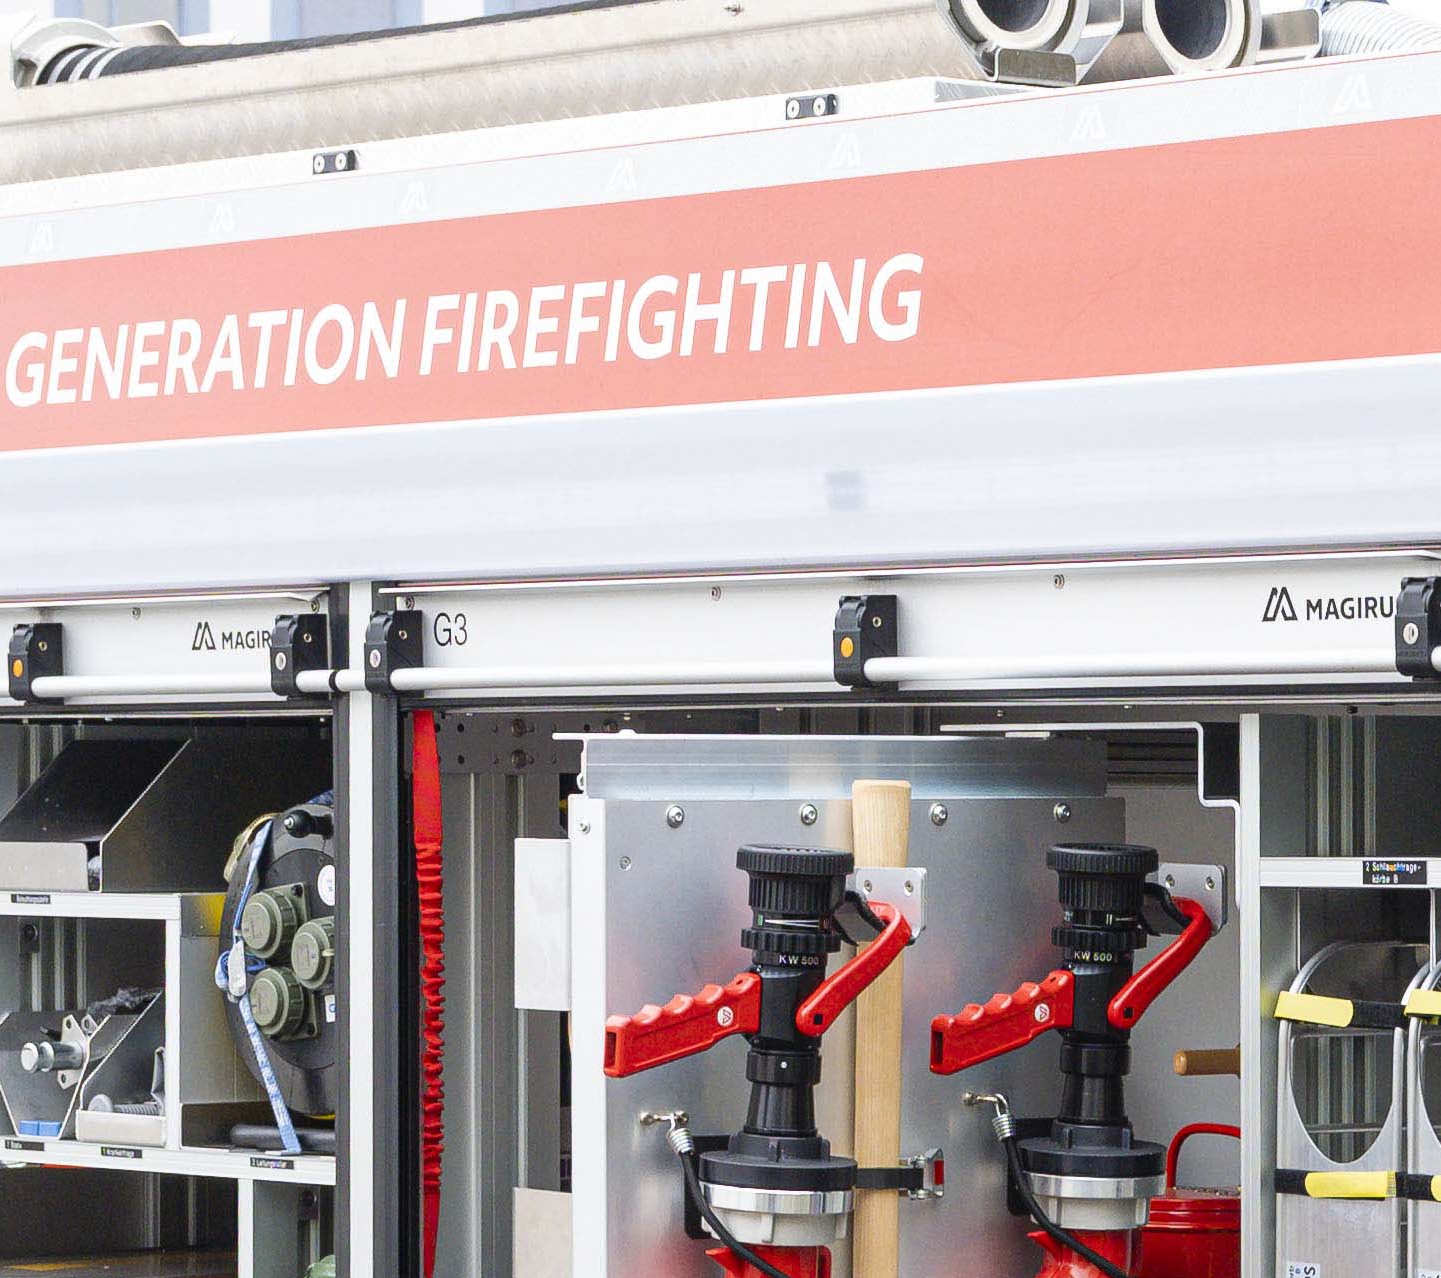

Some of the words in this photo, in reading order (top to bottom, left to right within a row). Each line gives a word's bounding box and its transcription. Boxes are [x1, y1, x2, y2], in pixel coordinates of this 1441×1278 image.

[4, 299, 406, 402] GENERATION
[419, 253, 925, 377] FIREFIGHTING
[1305, 593, 1397, 621] MAGIRU
[221, 631, 272, 650] MAGIR
[434, 609, 469, 647] G3
